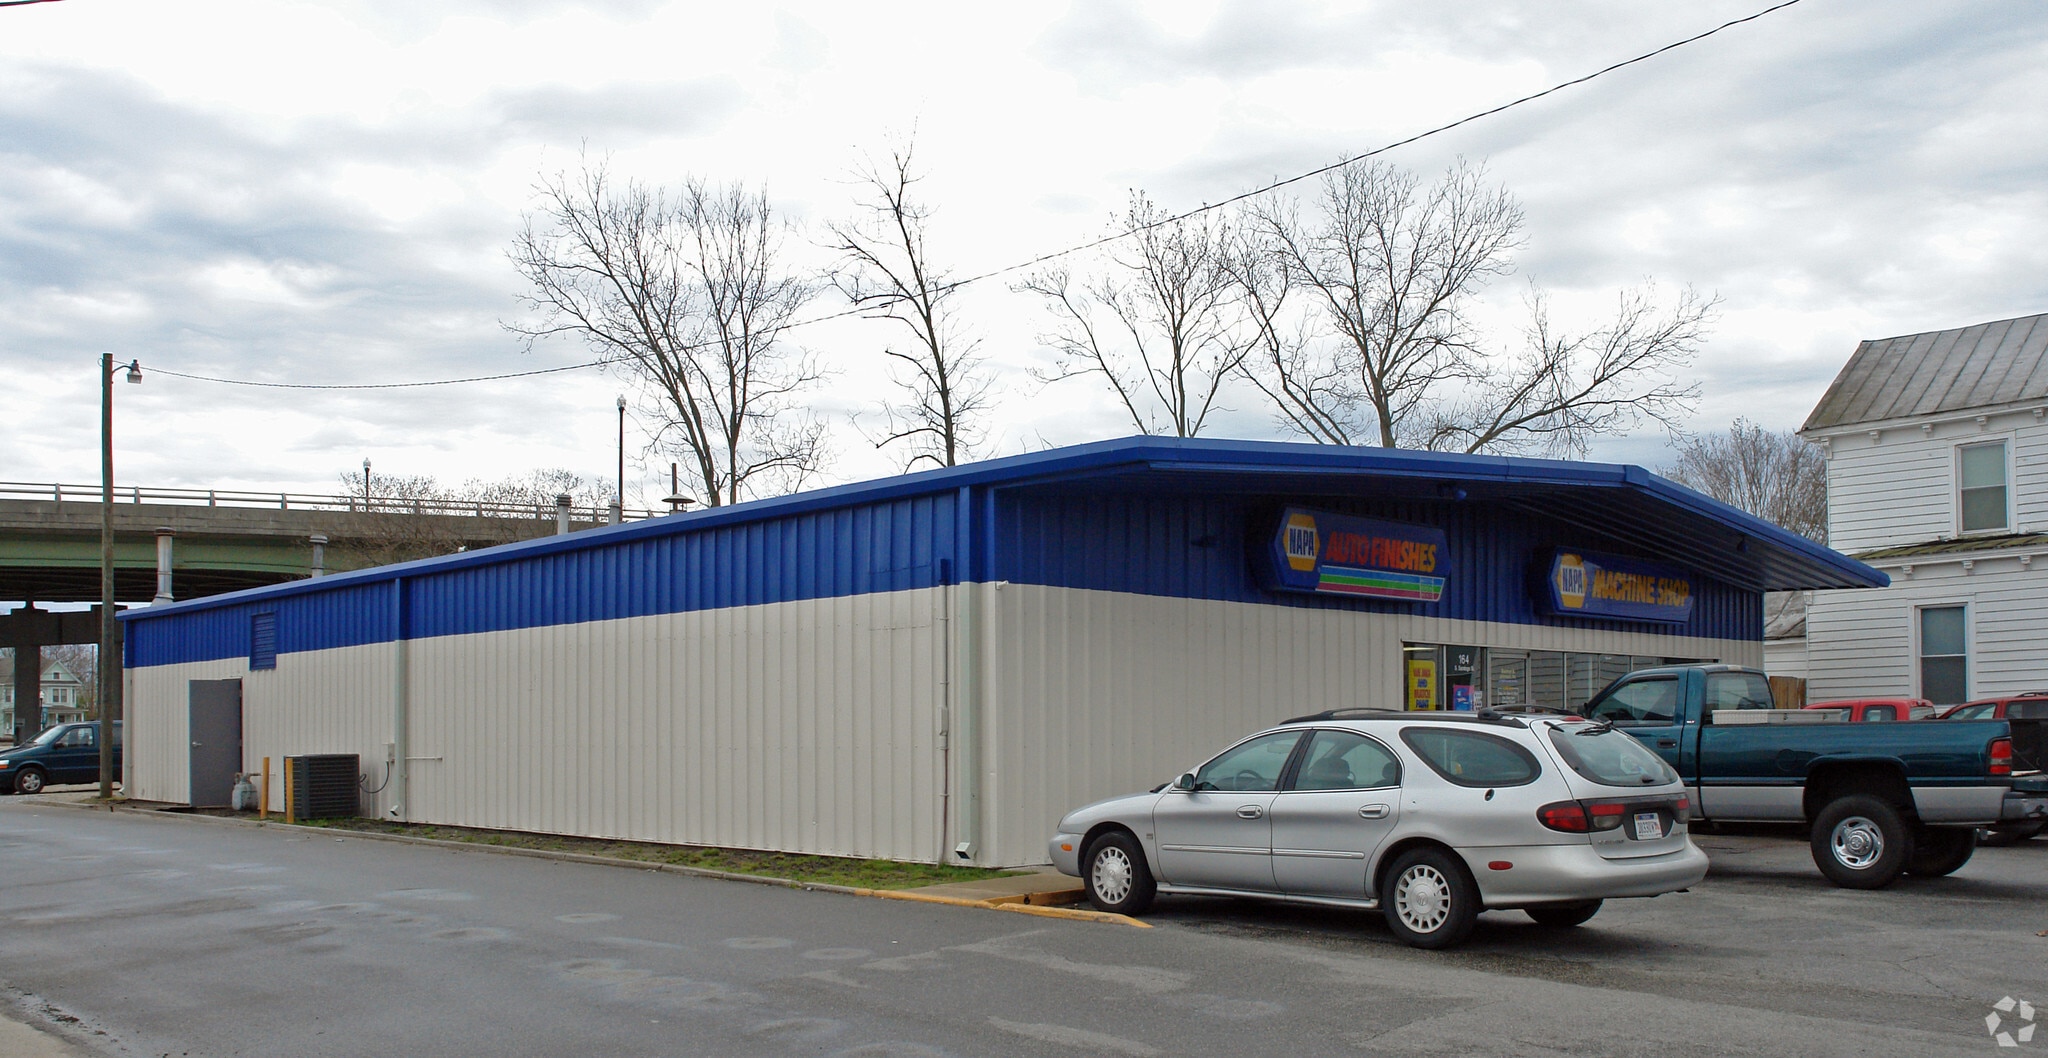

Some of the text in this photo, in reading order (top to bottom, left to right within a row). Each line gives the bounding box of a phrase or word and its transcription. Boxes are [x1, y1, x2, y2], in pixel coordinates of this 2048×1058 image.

[1289, 529, 1315, 557] NAPA
[1325, 531, 1437, 573] AUTO FINISHES
[1562, 567, 1583, 594] NAPA
[1592, 569, 1690, 607] MACHINE SHOP
[1459, 654, 1469, 664] 164
